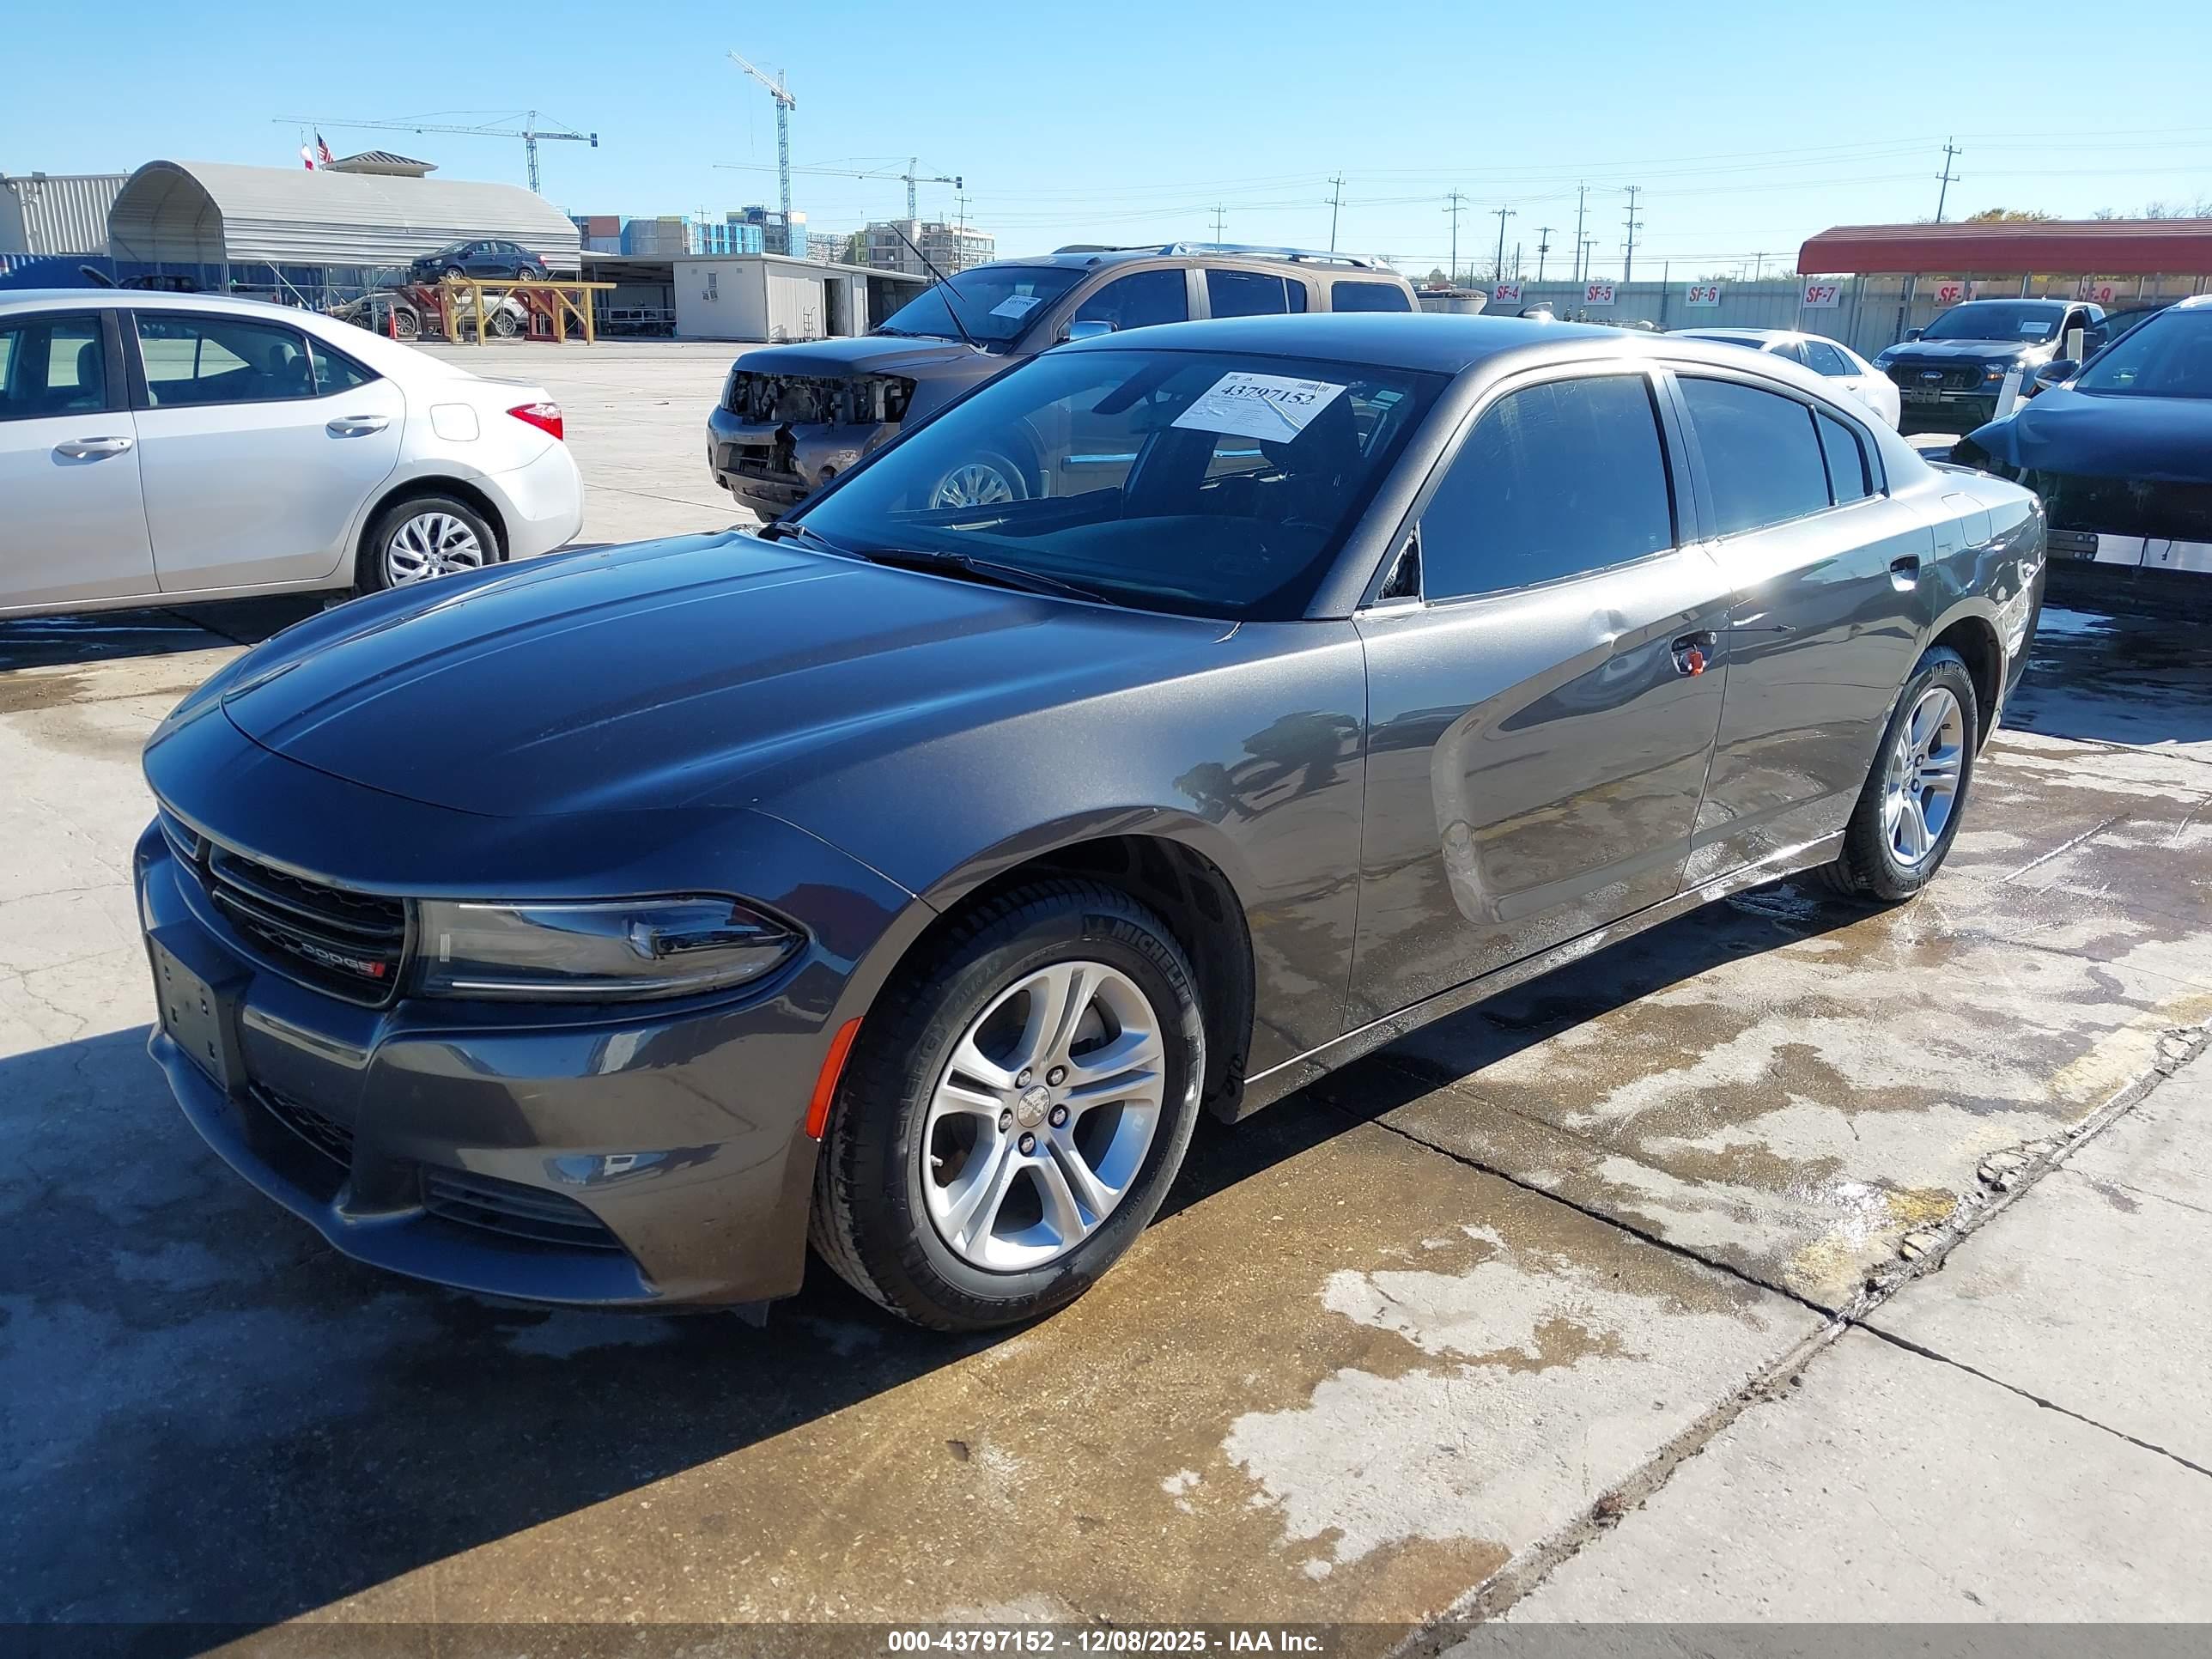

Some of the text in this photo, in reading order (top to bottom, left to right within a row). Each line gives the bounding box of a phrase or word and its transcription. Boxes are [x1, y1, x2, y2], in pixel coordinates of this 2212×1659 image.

[1497, 285, 1519, 300] SF-4
[1587, 286, 1612, 301] SF-5
[1689, 287, 1717, 301] SF-6
[1807, 287, 1836, 302] SF-7
[1221, 385, 1316, 404] 43797152
[301, 943, 374, 973] DODGE
[1113, 920, 1193, 1005] MICHELIN
